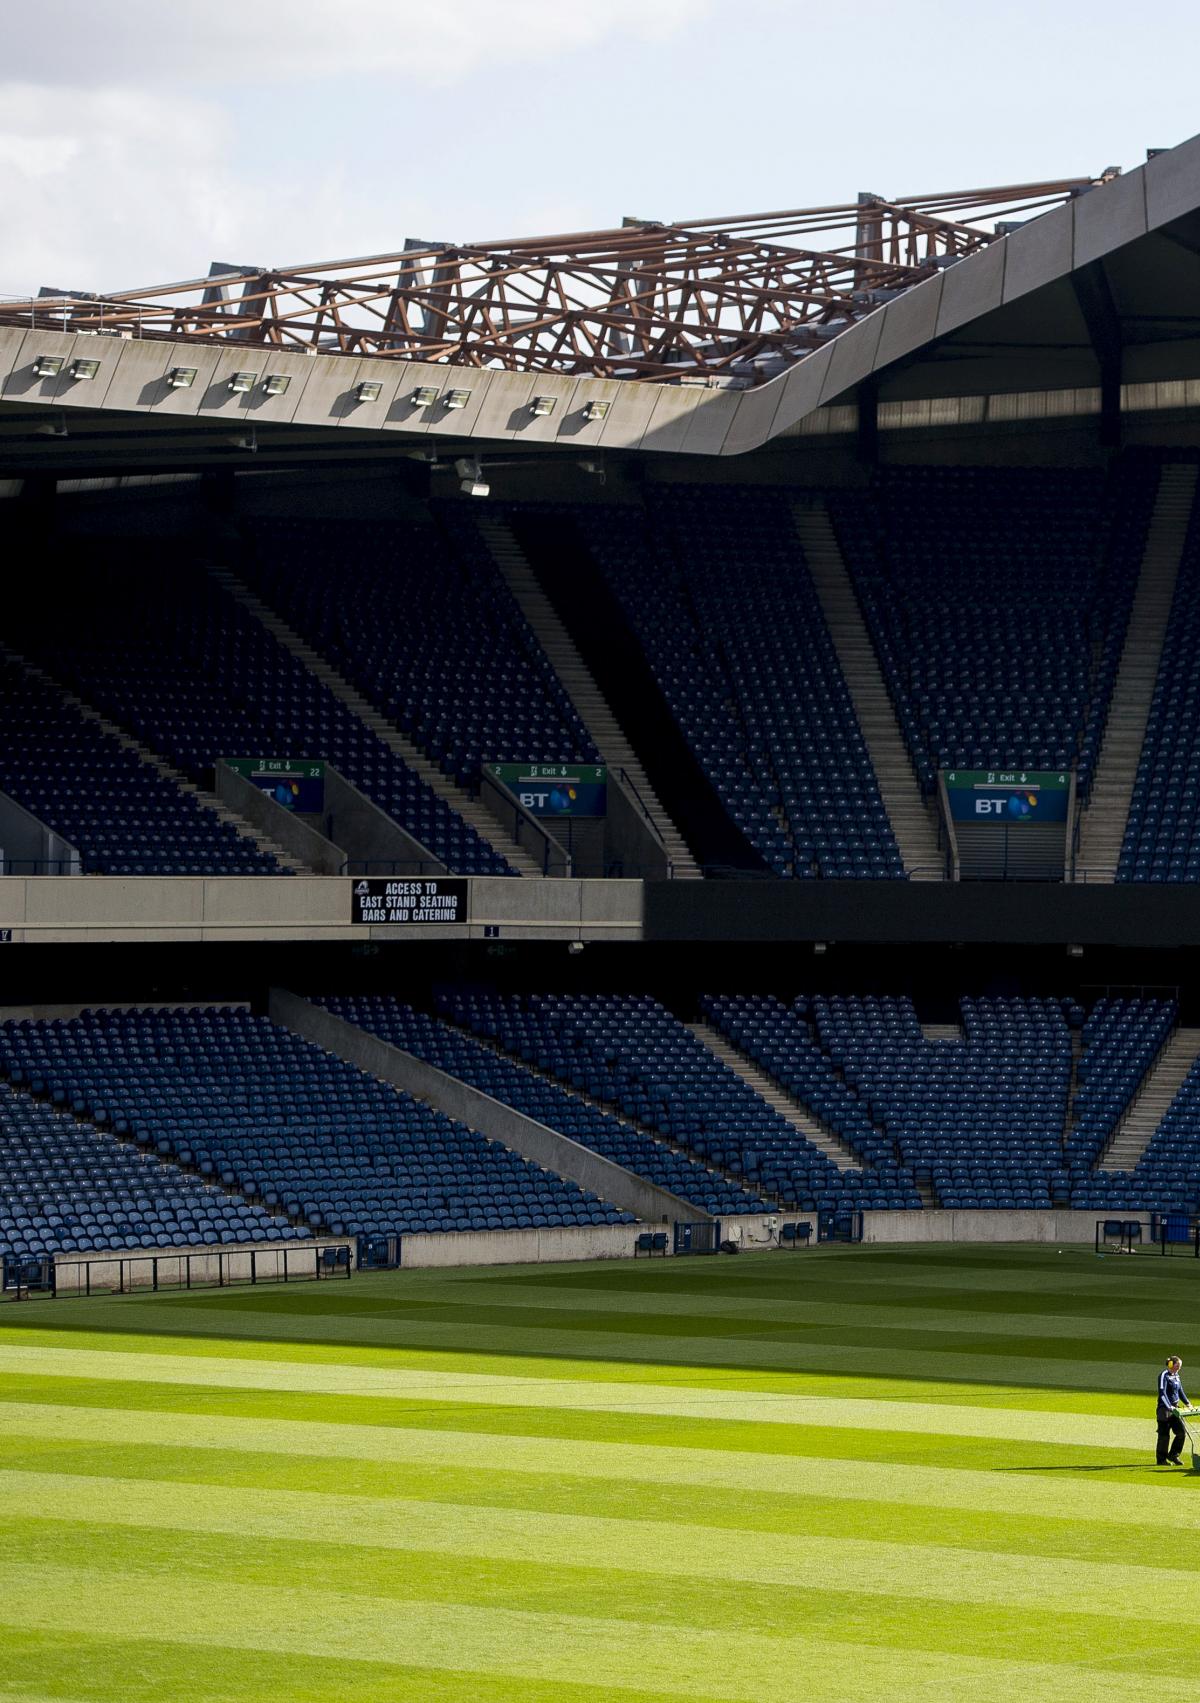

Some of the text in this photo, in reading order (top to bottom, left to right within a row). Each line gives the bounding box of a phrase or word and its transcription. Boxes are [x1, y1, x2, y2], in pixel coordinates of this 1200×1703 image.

[269, 762, 281, 770] Exit
[310, 768, 320, 776] 22
[495, 766, 601, 776] 2 Exit 2
[949, 773, 955, 781] 4
[1058, 775, 1065, 783] 4
[519, 793, 549, 808] BT
[975, 799, 1007, 814] BT
[385, 883, 437, 895] ACCESS TO
[360, 896, 458, 908] EAST STAND SEATING
[362, 909, 456, 921] BARS AND CATERING
[489, 926, 495, 936] 1
